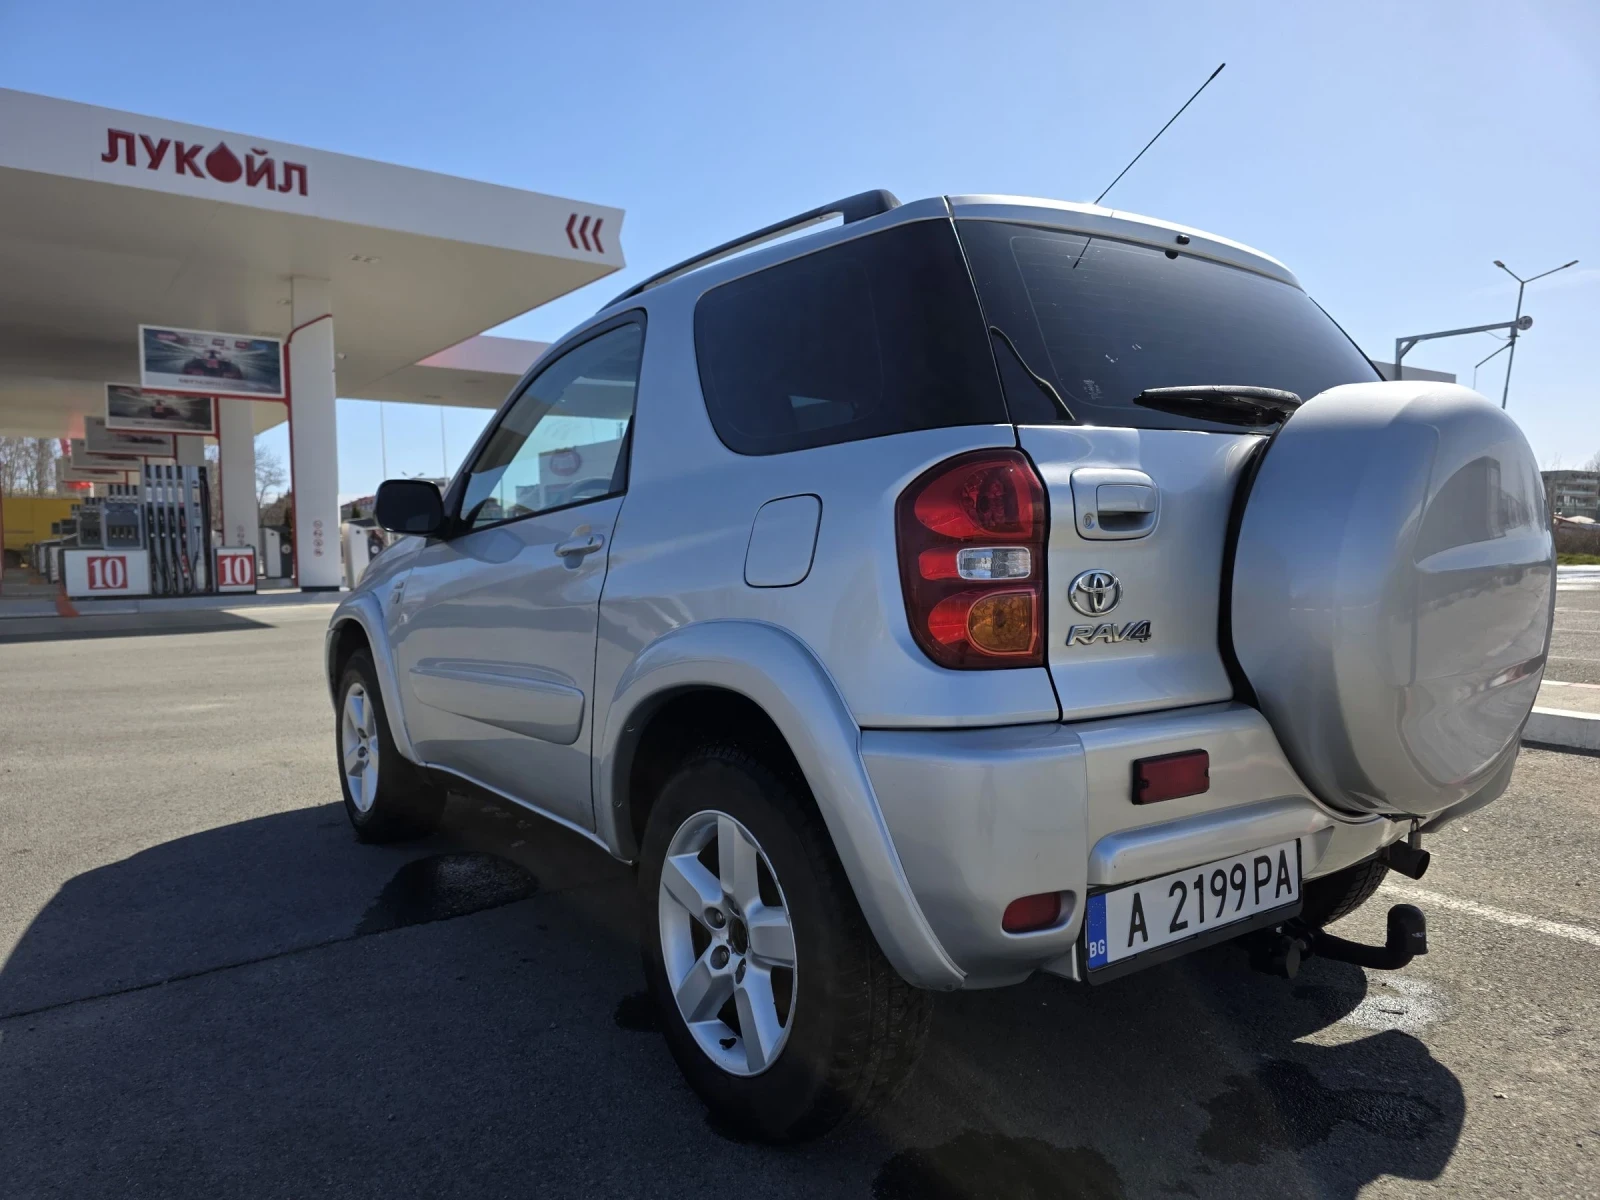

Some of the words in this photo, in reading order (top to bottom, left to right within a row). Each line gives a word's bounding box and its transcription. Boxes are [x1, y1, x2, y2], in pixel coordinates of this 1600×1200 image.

[91, 558, 124, 589] 10
[222, 556, 250, 585] 10
[1067, 620, 1152, 646] RAV4
[1089, 939, 1106, 958] BG
